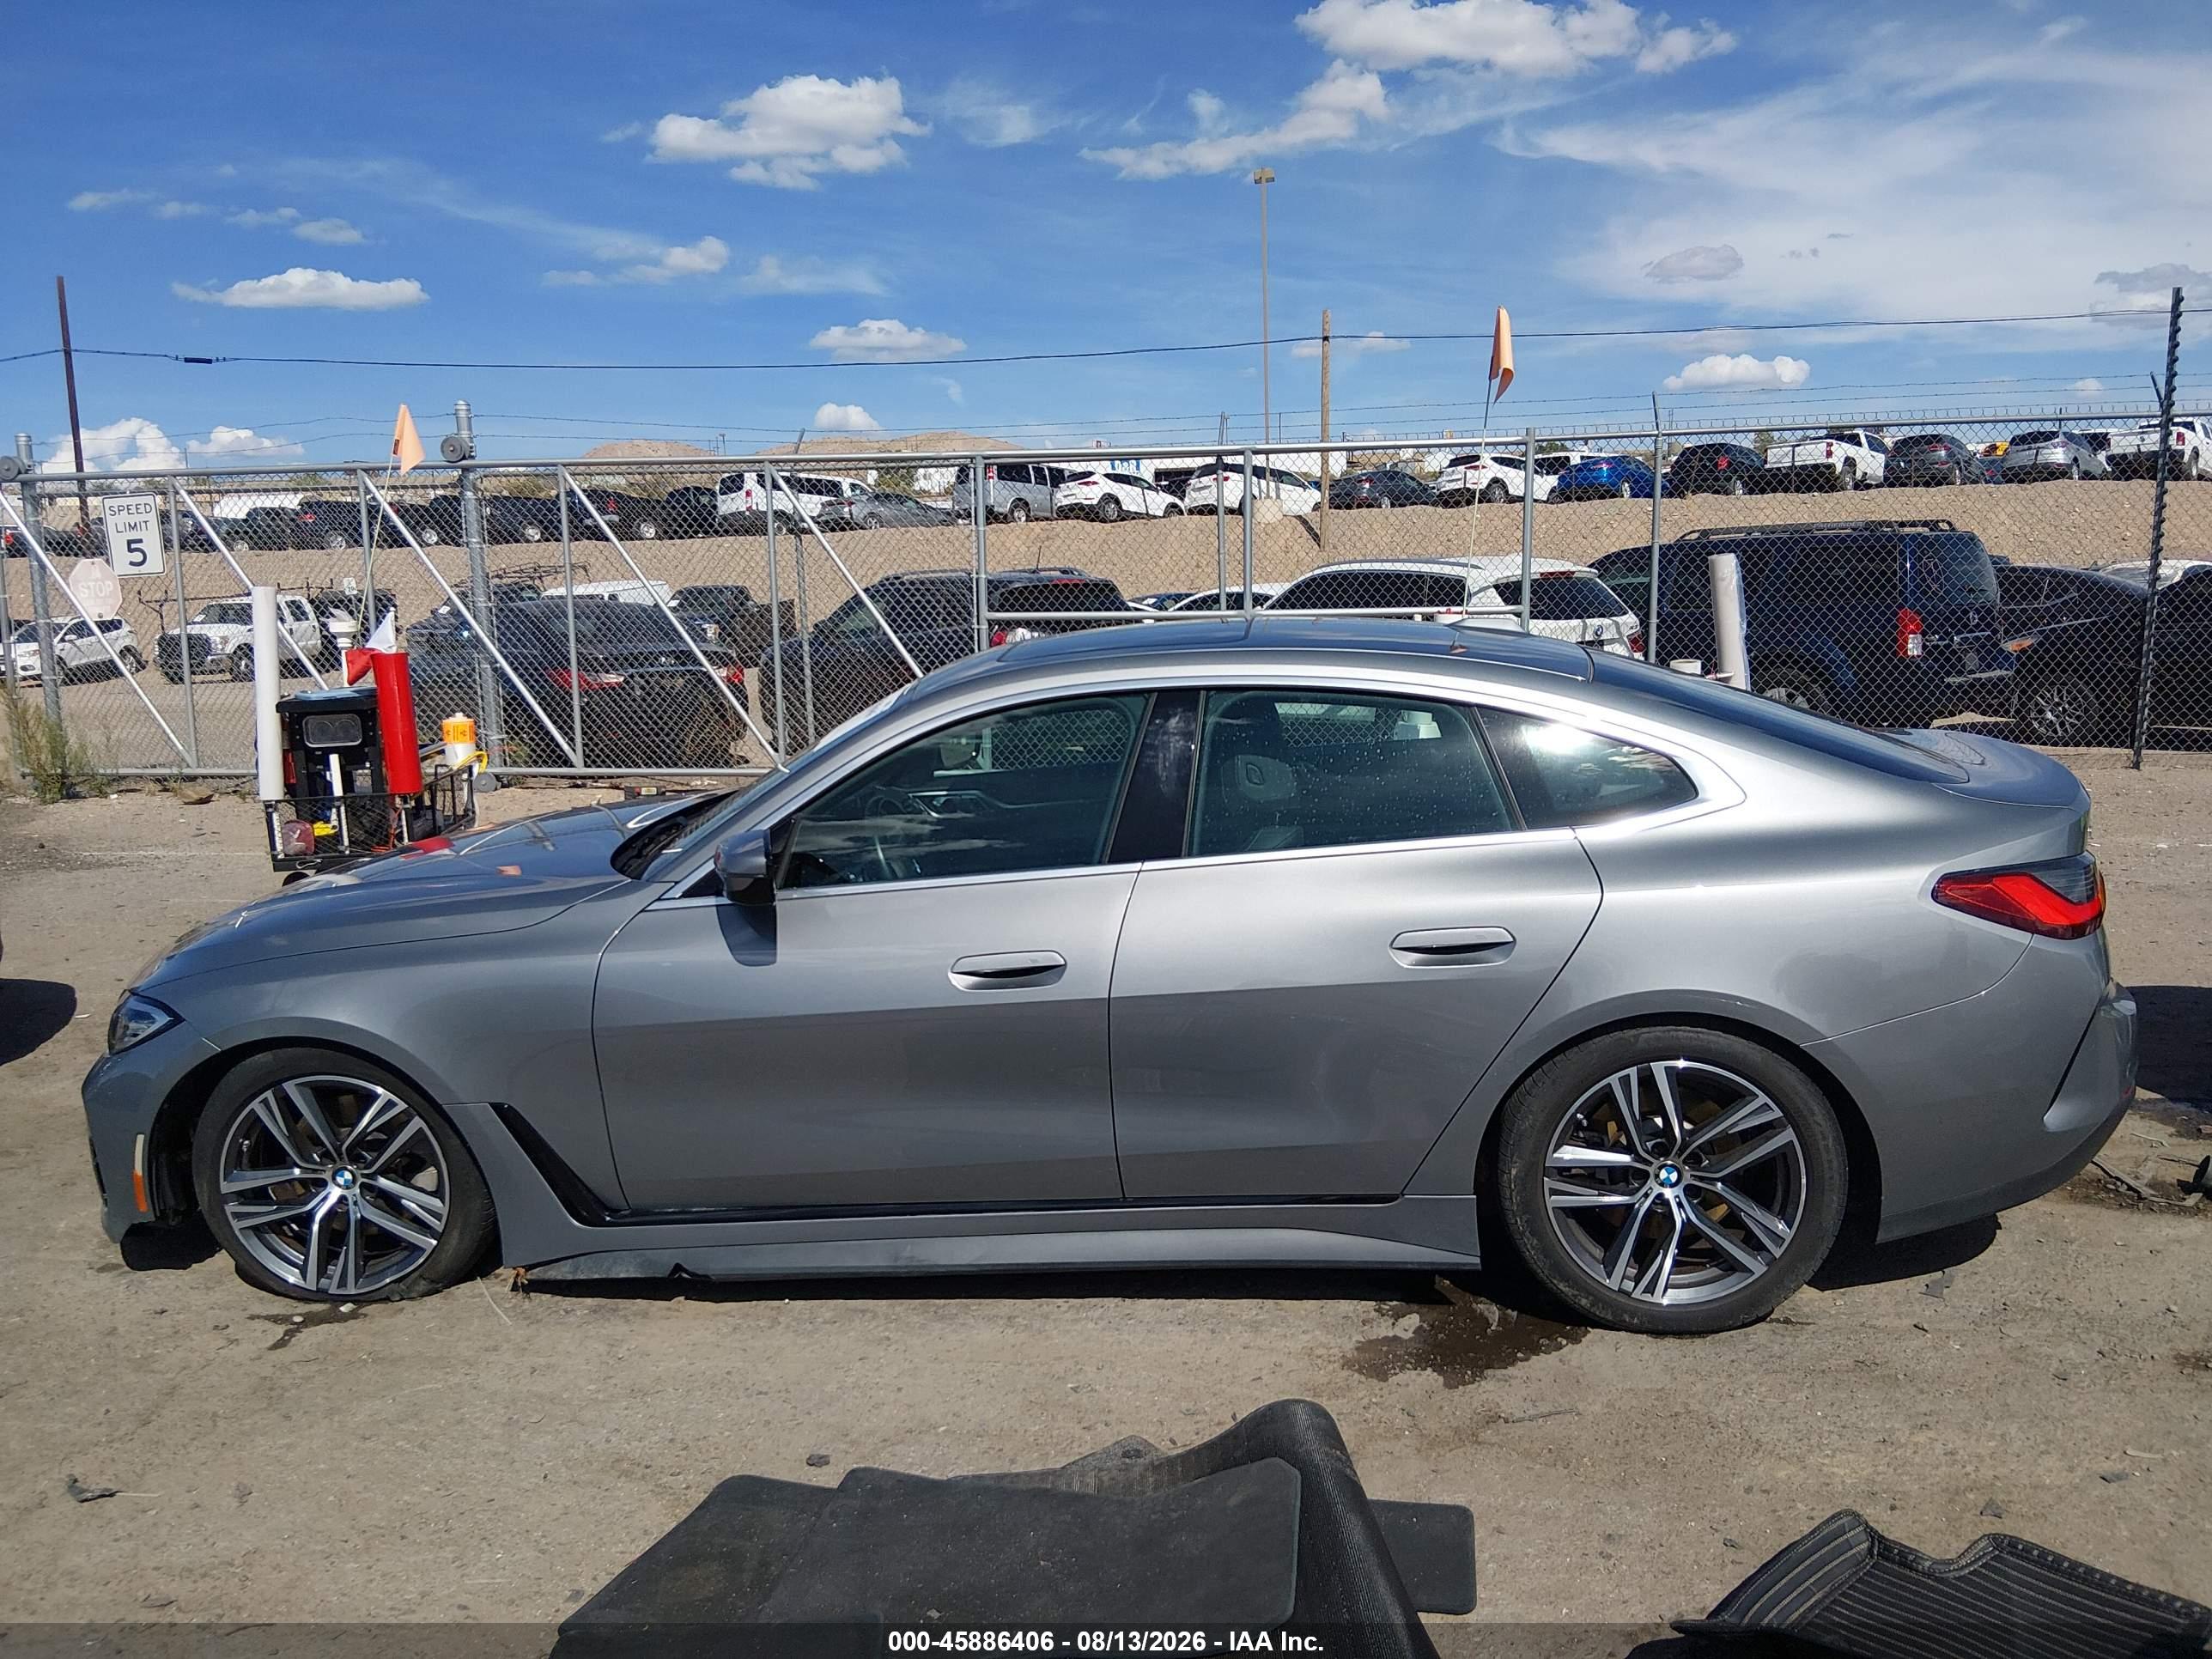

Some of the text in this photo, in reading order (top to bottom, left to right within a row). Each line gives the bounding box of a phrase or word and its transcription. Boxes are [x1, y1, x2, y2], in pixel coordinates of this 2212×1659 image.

[108, 502, 153, 517] SPEED
[115, 520, 150, 533] LIMIT
[126, 538, 148, 568] 5
[78, 580, 113, 598] STOP
